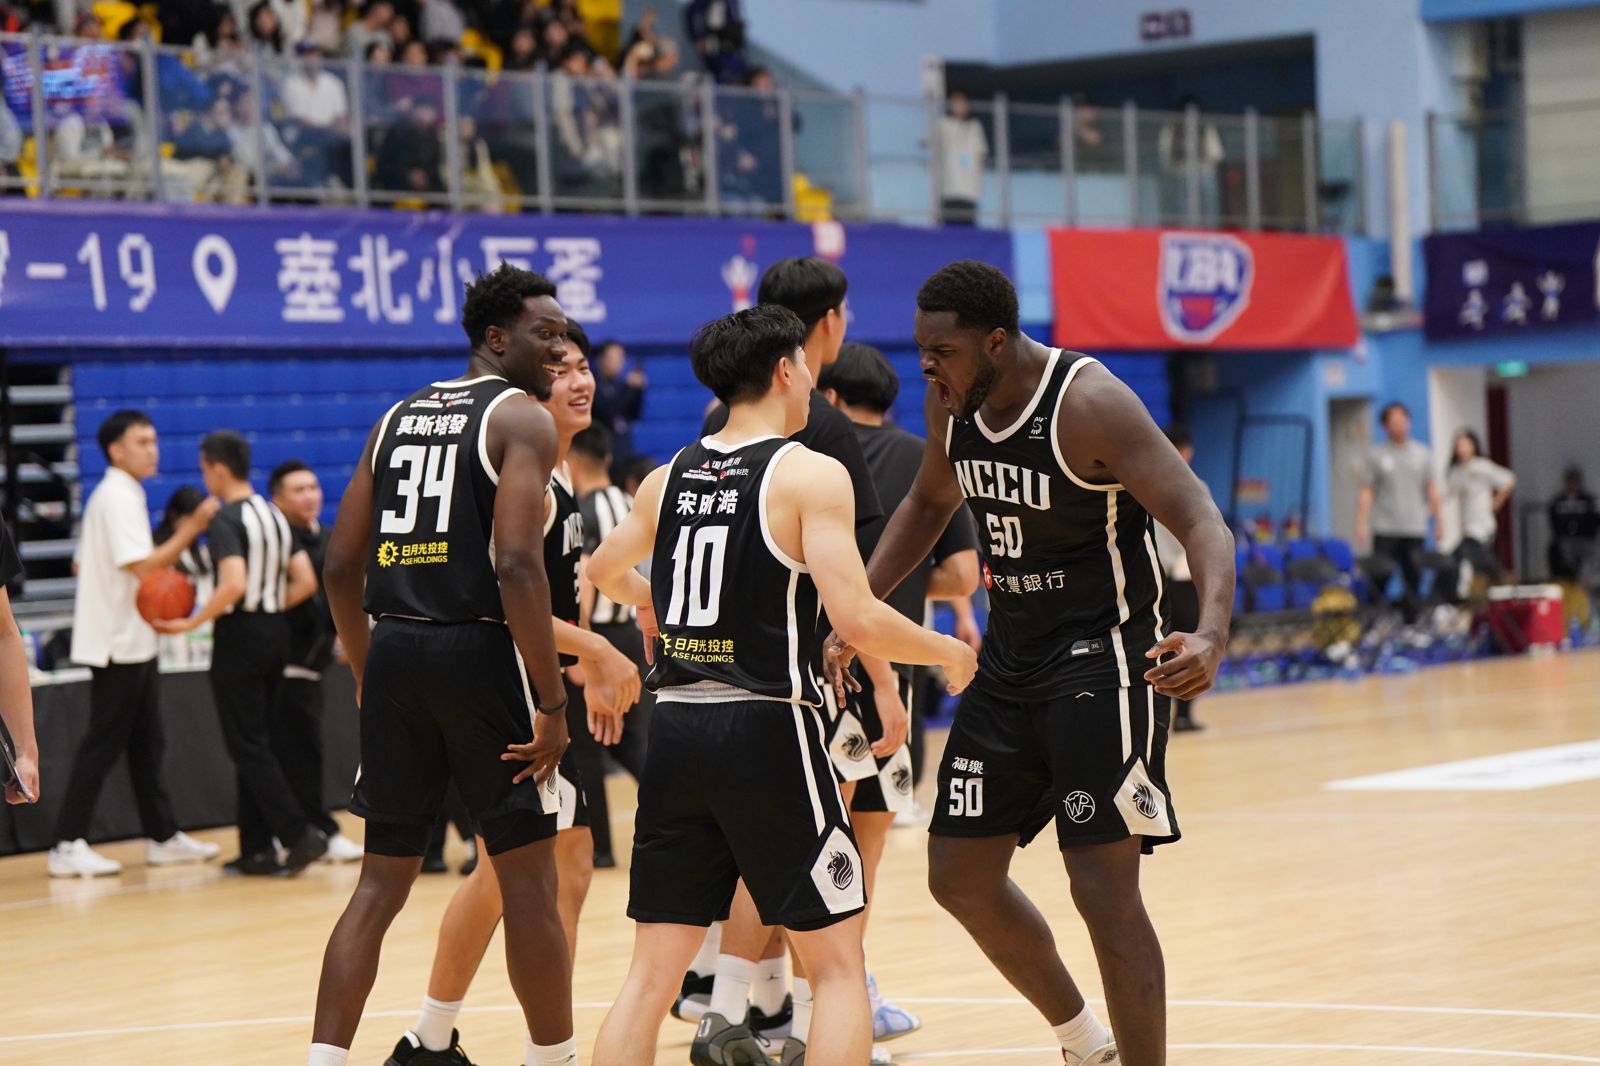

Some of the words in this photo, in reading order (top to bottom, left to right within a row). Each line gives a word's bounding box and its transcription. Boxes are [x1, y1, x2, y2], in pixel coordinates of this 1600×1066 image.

[396, 414, 469, 436] 莫斯塔發
[380, 444, 458, 534] 34
[954, 460, 1051, 511] NCCU
[676, 489, 739, 515] 宋昕澔
[986, 512, 1023, 558] 50
[400, 557, 413, 565] ASE
[413, 555, 448, 564] HOLDINGS
[402, 541, 448, 557] 日月光投控
[665, 526, 729, 627] 10
[672, 651, 689, 660] ASE
[691, 654, 735, 663] HOLDINGS
[675, 637, 734, 653] 日月光投控
[952, 756, 984, 774] 福樂
[949, 777, 984, 817] 50
